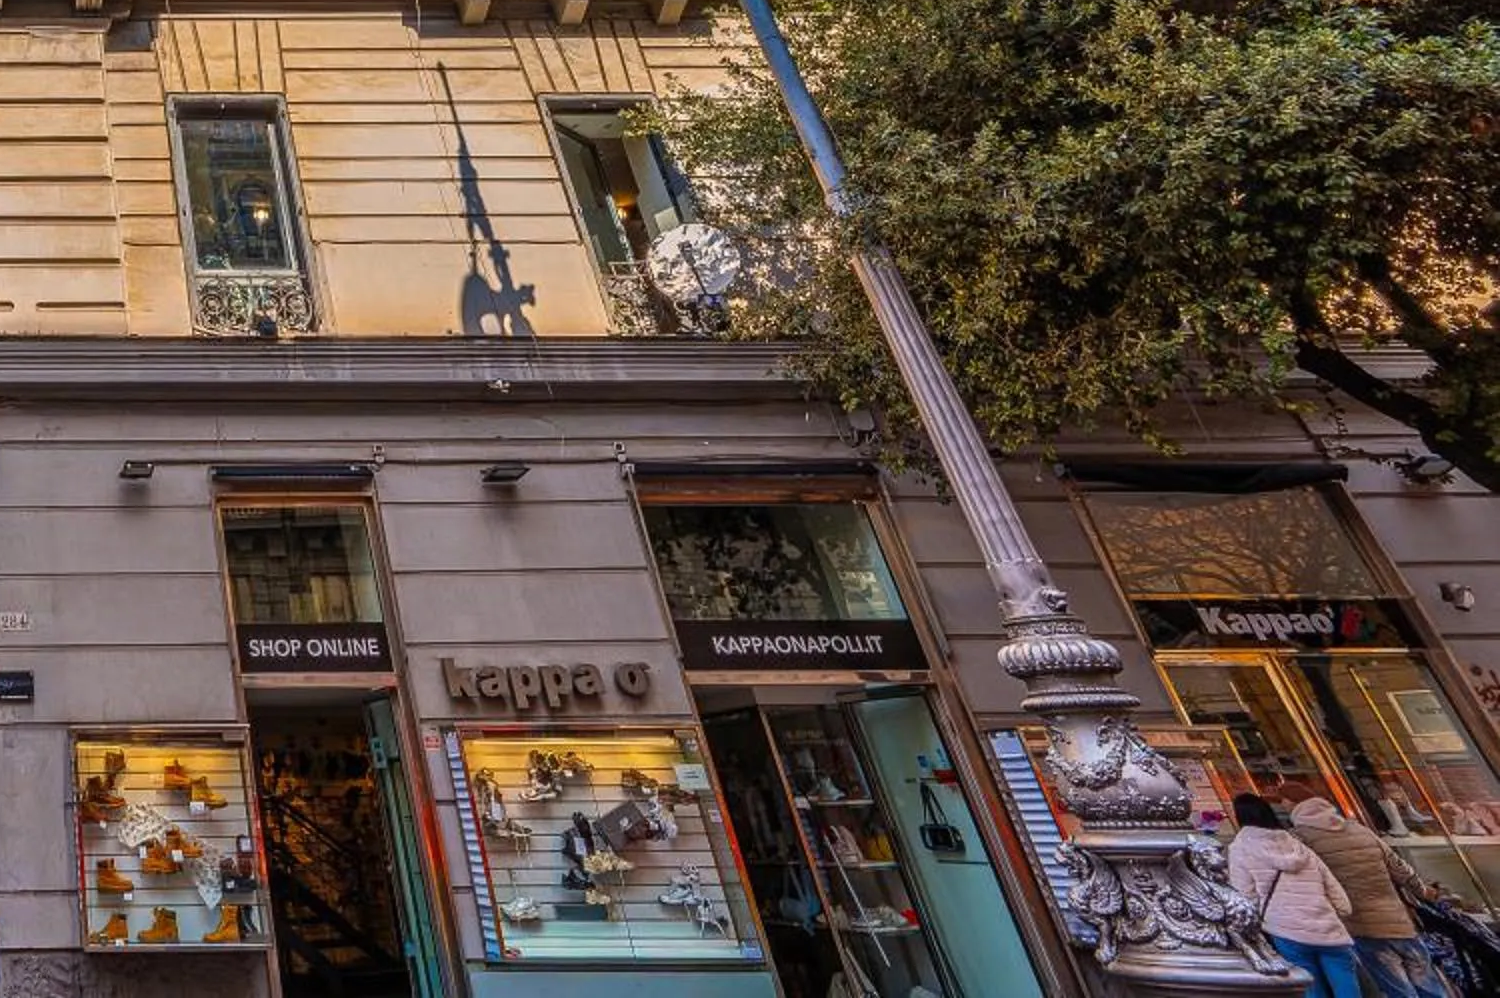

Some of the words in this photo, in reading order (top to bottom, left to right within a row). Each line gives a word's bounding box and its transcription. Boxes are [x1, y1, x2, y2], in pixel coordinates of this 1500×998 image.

[249, 639, 301, 657] SHOP
[306, 638, 381, 657] ONLINE
[441, 657, 606, 709] kappa
